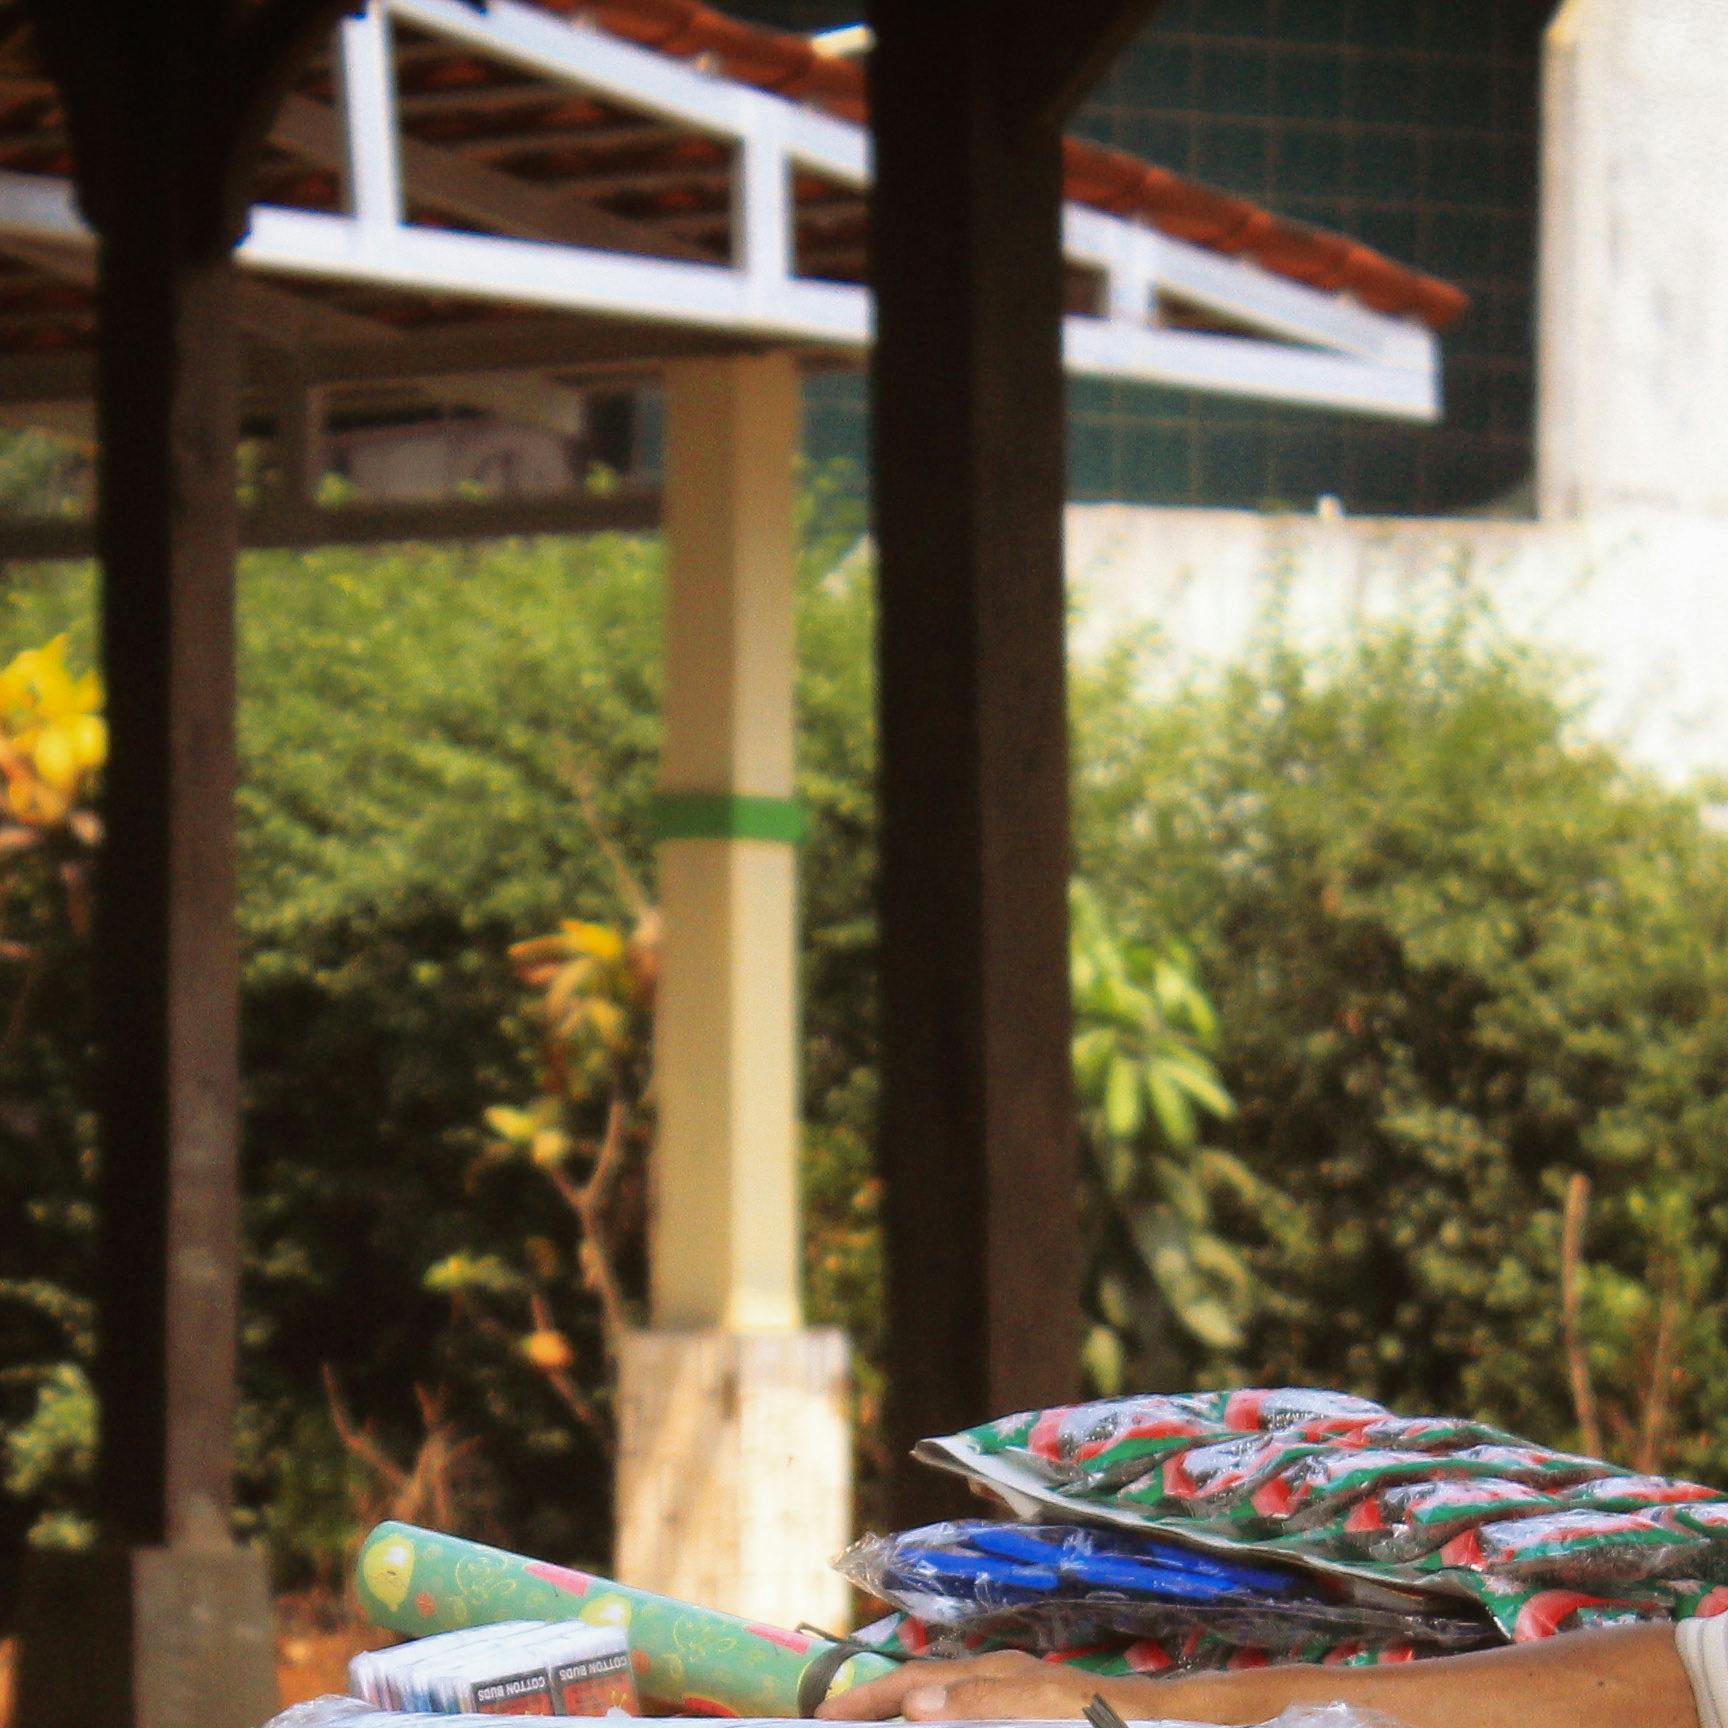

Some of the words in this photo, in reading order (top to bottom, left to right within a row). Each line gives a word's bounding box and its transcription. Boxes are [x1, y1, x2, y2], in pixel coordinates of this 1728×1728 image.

[559, 1664, 587, 1681] BUDS
[478, 1683, 505, 1701] BUDS
[505, 1676, 546, 1697] COTTON
